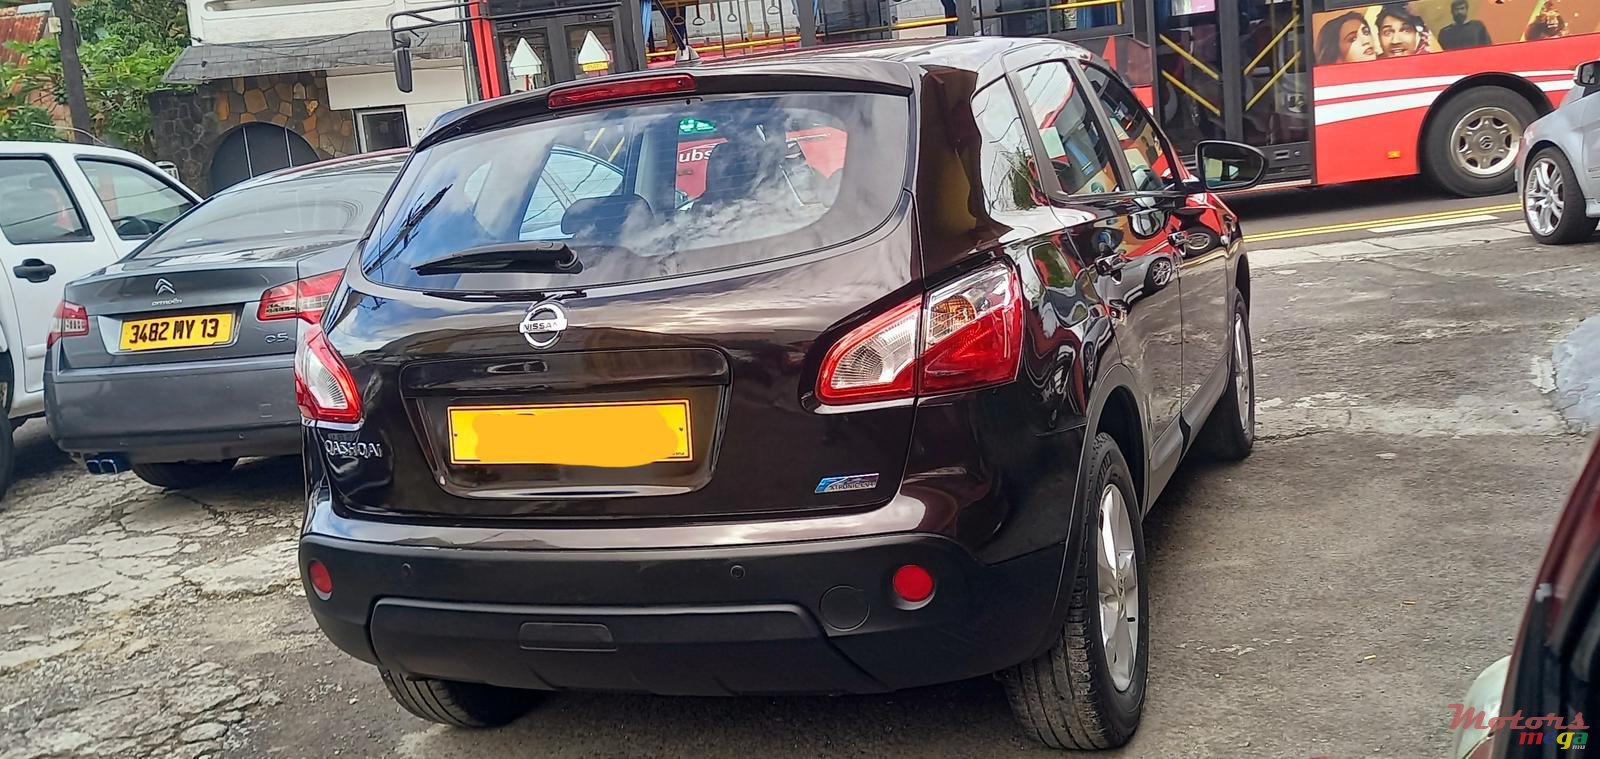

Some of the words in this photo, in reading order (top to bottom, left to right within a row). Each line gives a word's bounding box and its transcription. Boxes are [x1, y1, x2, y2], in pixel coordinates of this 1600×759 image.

[129, 323, 170, 344] 3482
[172, 319, 195, 340] MY
[201, 317, 220, 338] 13
